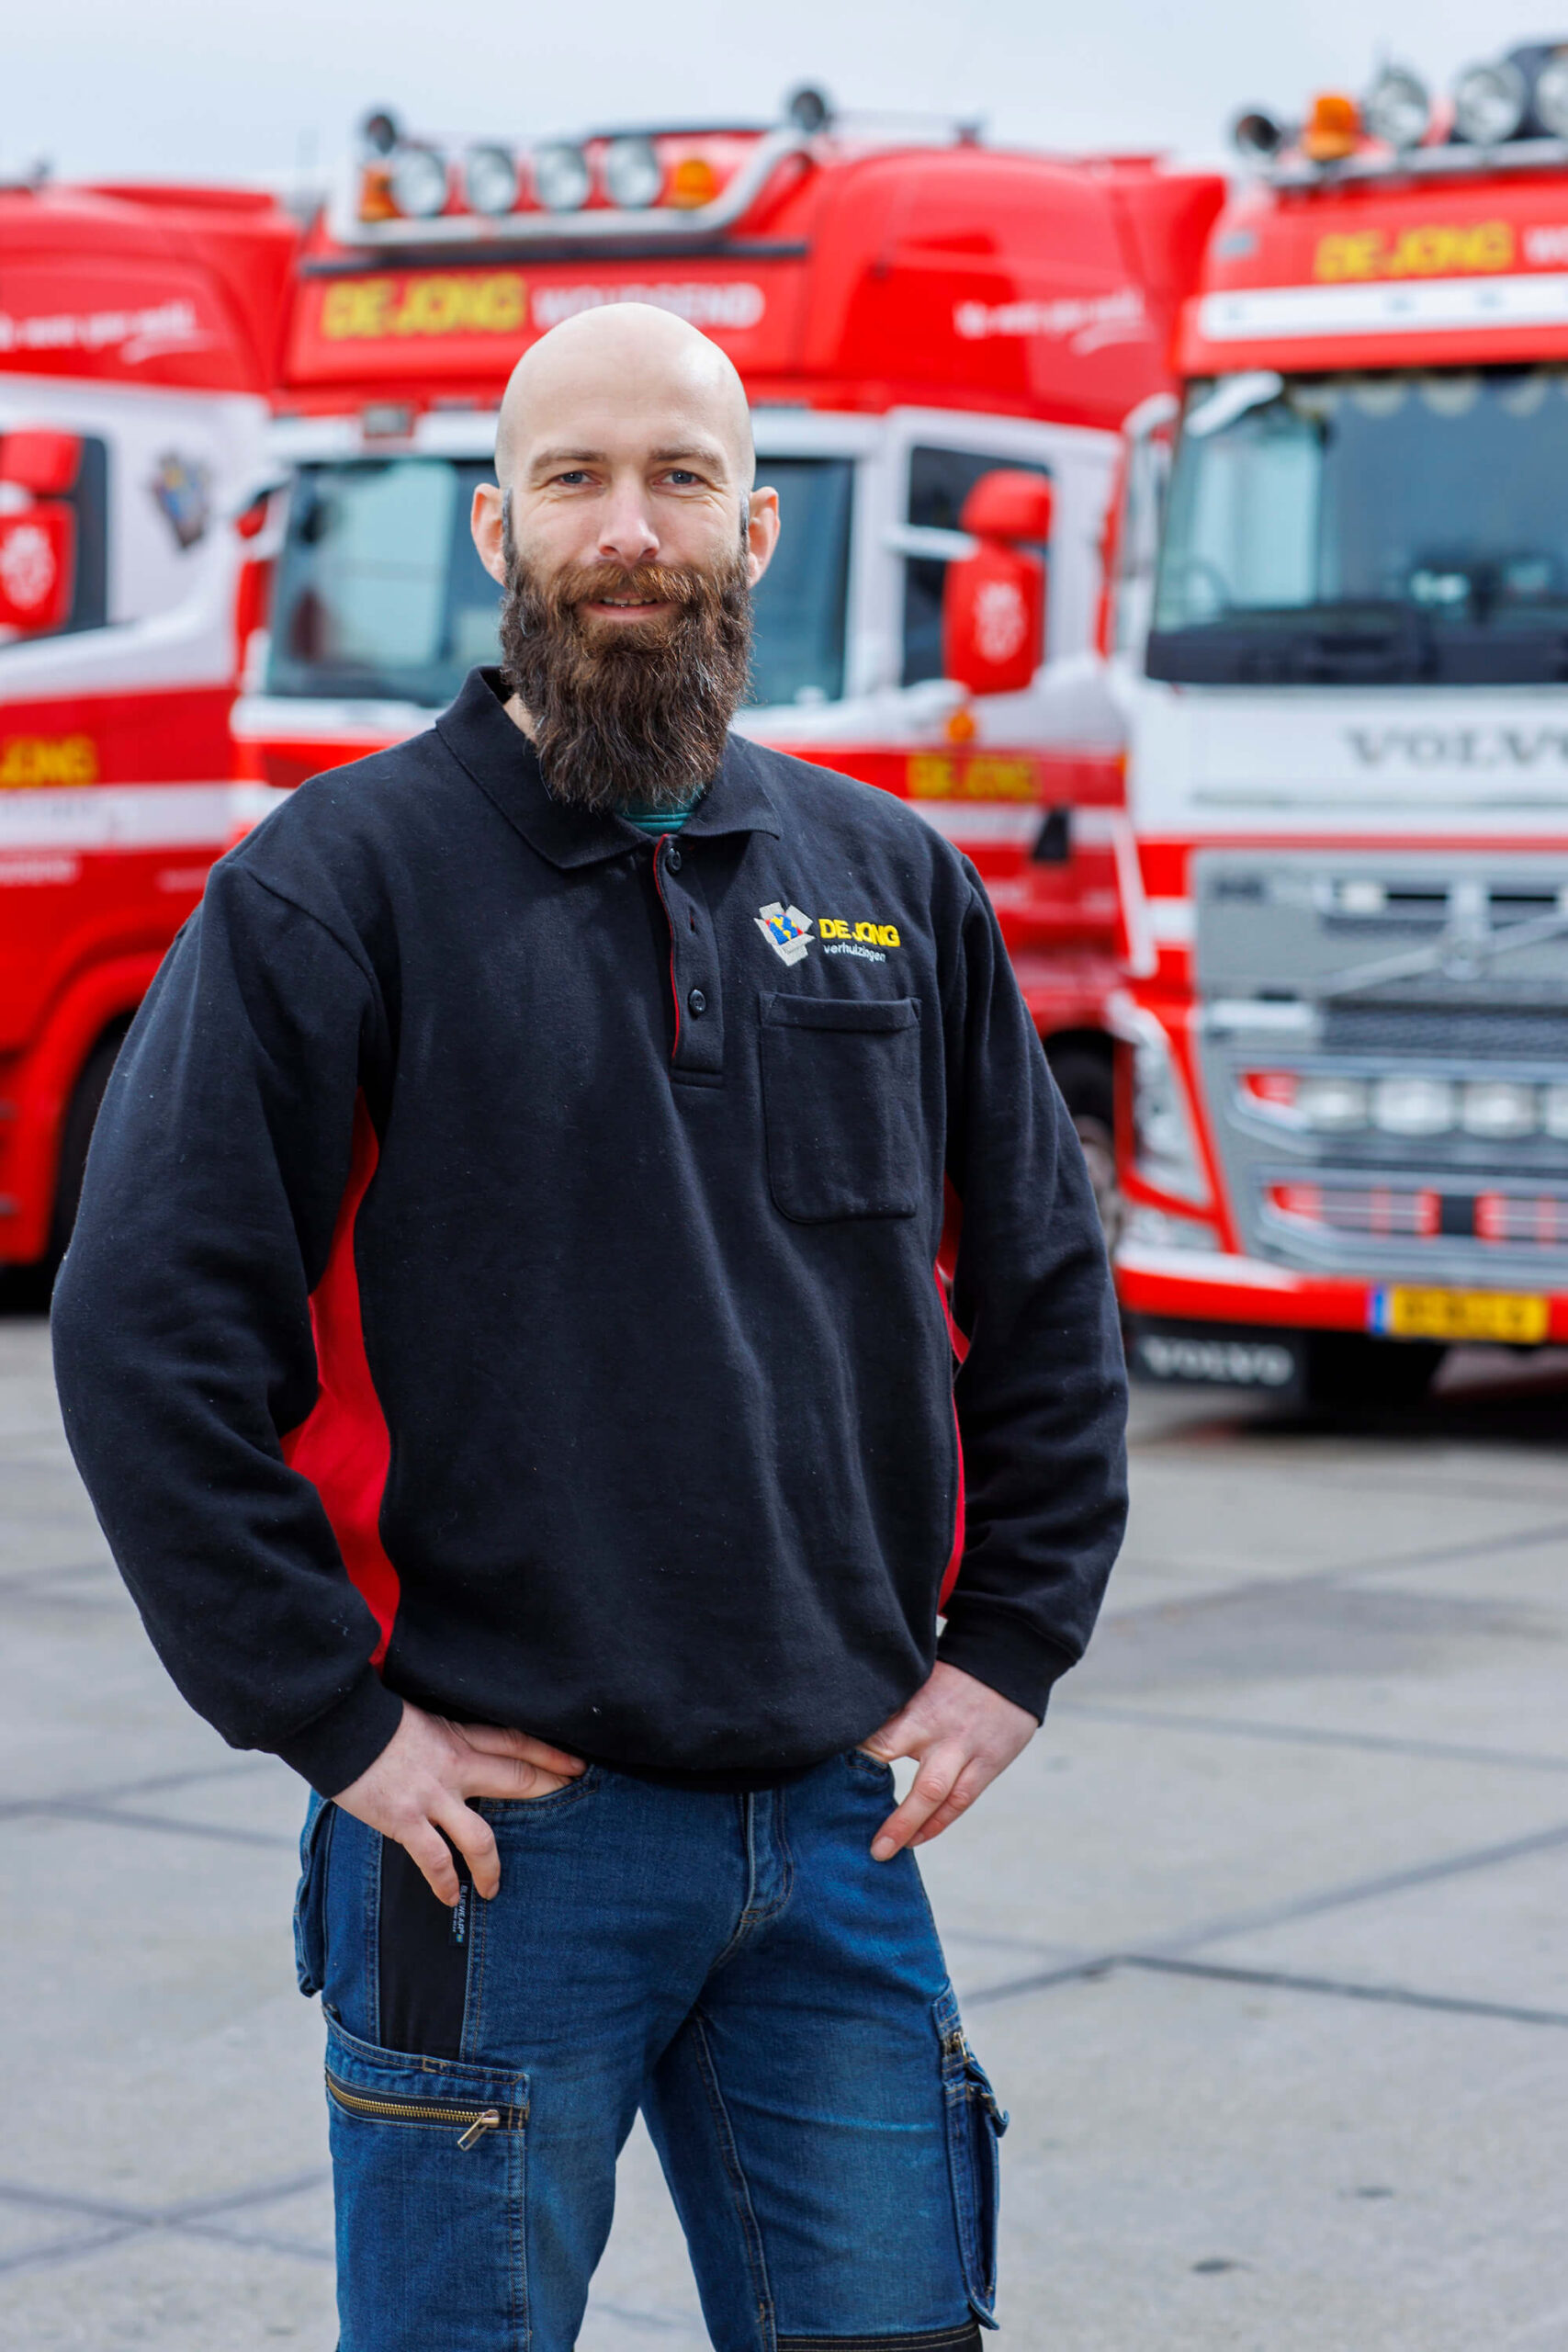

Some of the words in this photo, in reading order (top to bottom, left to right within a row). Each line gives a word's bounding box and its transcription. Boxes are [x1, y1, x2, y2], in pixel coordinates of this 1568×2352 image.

[1385, 221, 1513, 278] JONG
[322, 280, 393, 339] DE
[396, 275, 526, 335] JONG
[1341, 722, 1568, 768] VOLV
[818, 919, 852, 939] DE
[852, 922, 901, 947] JONG
[823, 942, 886, 963] verhuizingen
[1142, 1336, 1294, 1385] VOLVO
